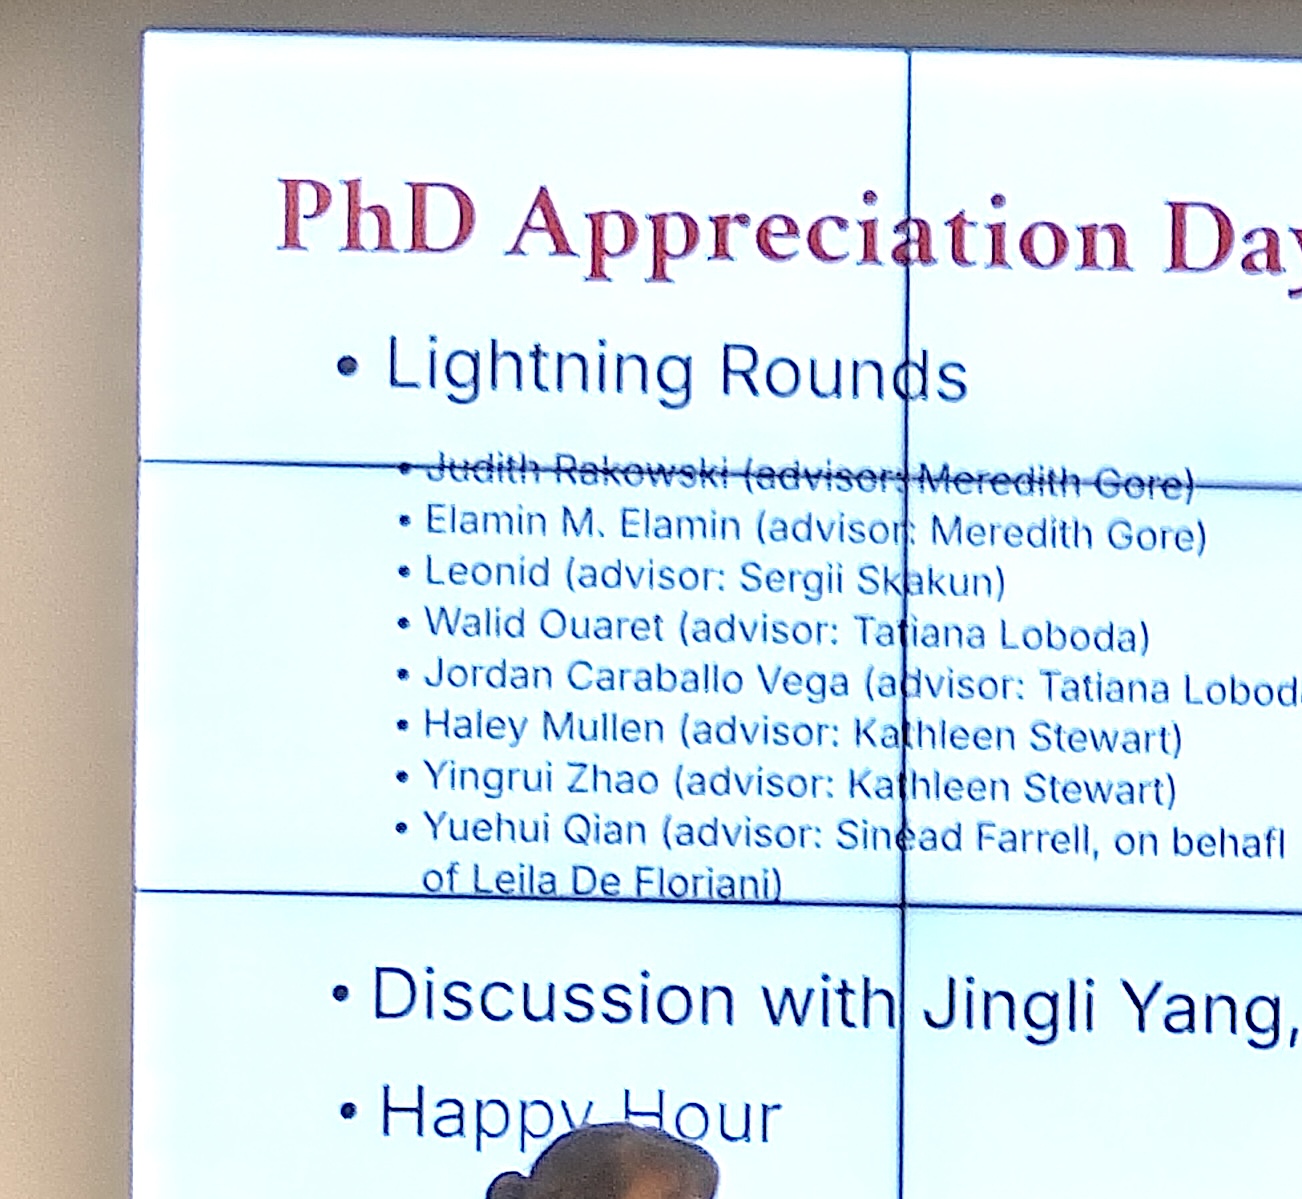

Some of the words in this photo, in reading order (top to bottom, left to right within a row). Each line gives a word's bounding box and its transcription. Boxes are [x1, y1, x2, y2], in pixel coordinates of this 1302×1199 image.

[276, 178, 476, 253] PhD
[504, 184, 1134, 283] Appreciation
[389, 336, 692, 409] Lightning
[721, 344, 968, 402] Rounds
[427, 452, 540, 484] Judith
[554, 453, 729, 488] Rakowski
[744, 458, 907, 497] (advisor:
[920, 464, 1080, 497] Meredith
[1093, 467, 1195, 504] Gore)
[427, 503, 547, 537] Elamin
[562, 505, 605, 538] M.
[620, 507, 740, 542] Elamin
[757, 509, 915, 548] (advisor:
[932, 515, 1092, 549] Meredith
[1107, 518, 1207, 557] Gore)
[427, 556, 550, 588] Leonid
[567, 557, 724, 593] (advisor:
[740, 561, 842, 601] Sergii
[857, 564, 1005, 601] Skakun)
[425, 605, 525, 638] Walid
[540, 608, 664, 642] Ouaret
[680, 610, 838, 647] (advisor:
[855, 615, 985, 648] Tatiana
[1000, 619, 1149, 655] Loboda)
[424, 657, 552, 690] Jordan
[568, 660, 744, 693] Caraballo
[758, 665, 850, 702] Vega
[865, 666, 1025, 702] (advisor:
[1040, 668, 1170, 704] Tatiana
[425, 709, 528, 747] Haley
[543, 711, 664, 744] Mullen
[680, 713, 838, 750] (advisor:
[855, 717, 1014, 752] Kathleen
[1030, 722, 1182, 759] Stewart)
[423, 760, 553, 798] Yingrui
[567, 762, 658, 795] Zhao
[674, 764, 834, 801] (advisor:
[849, 769, 1010, 803] Kathleen
[1024, 773, 1177, 810] Stewart)
[423, 811, 550, 844] Yuehui
[564, 813, 646, 848] Qian
[662, 814, 822, 851] (advisor:
[836, 819, 961, 852] Sinead
[977, 822, 1100, 861] Farrell,
[1115, 827, 1158, 856] on
[1173, 826, 1285, 859] behafl
[422, 862, 459, 894] of
[474, 864, 557, 898] Leila
[571, 866, 622, 900] De
[634, 868, 783, 906] Floriani)
[374, 966, 734, 1026] Discussion
[761, 972, 896, 1029] with
[924, 976, 1095, 1045] Jingli
[1120, 978, 1299, 1049] Yang,
[382, 1084, 591, 1152] Happy
[624, 1089, 782, 1142] Hour
